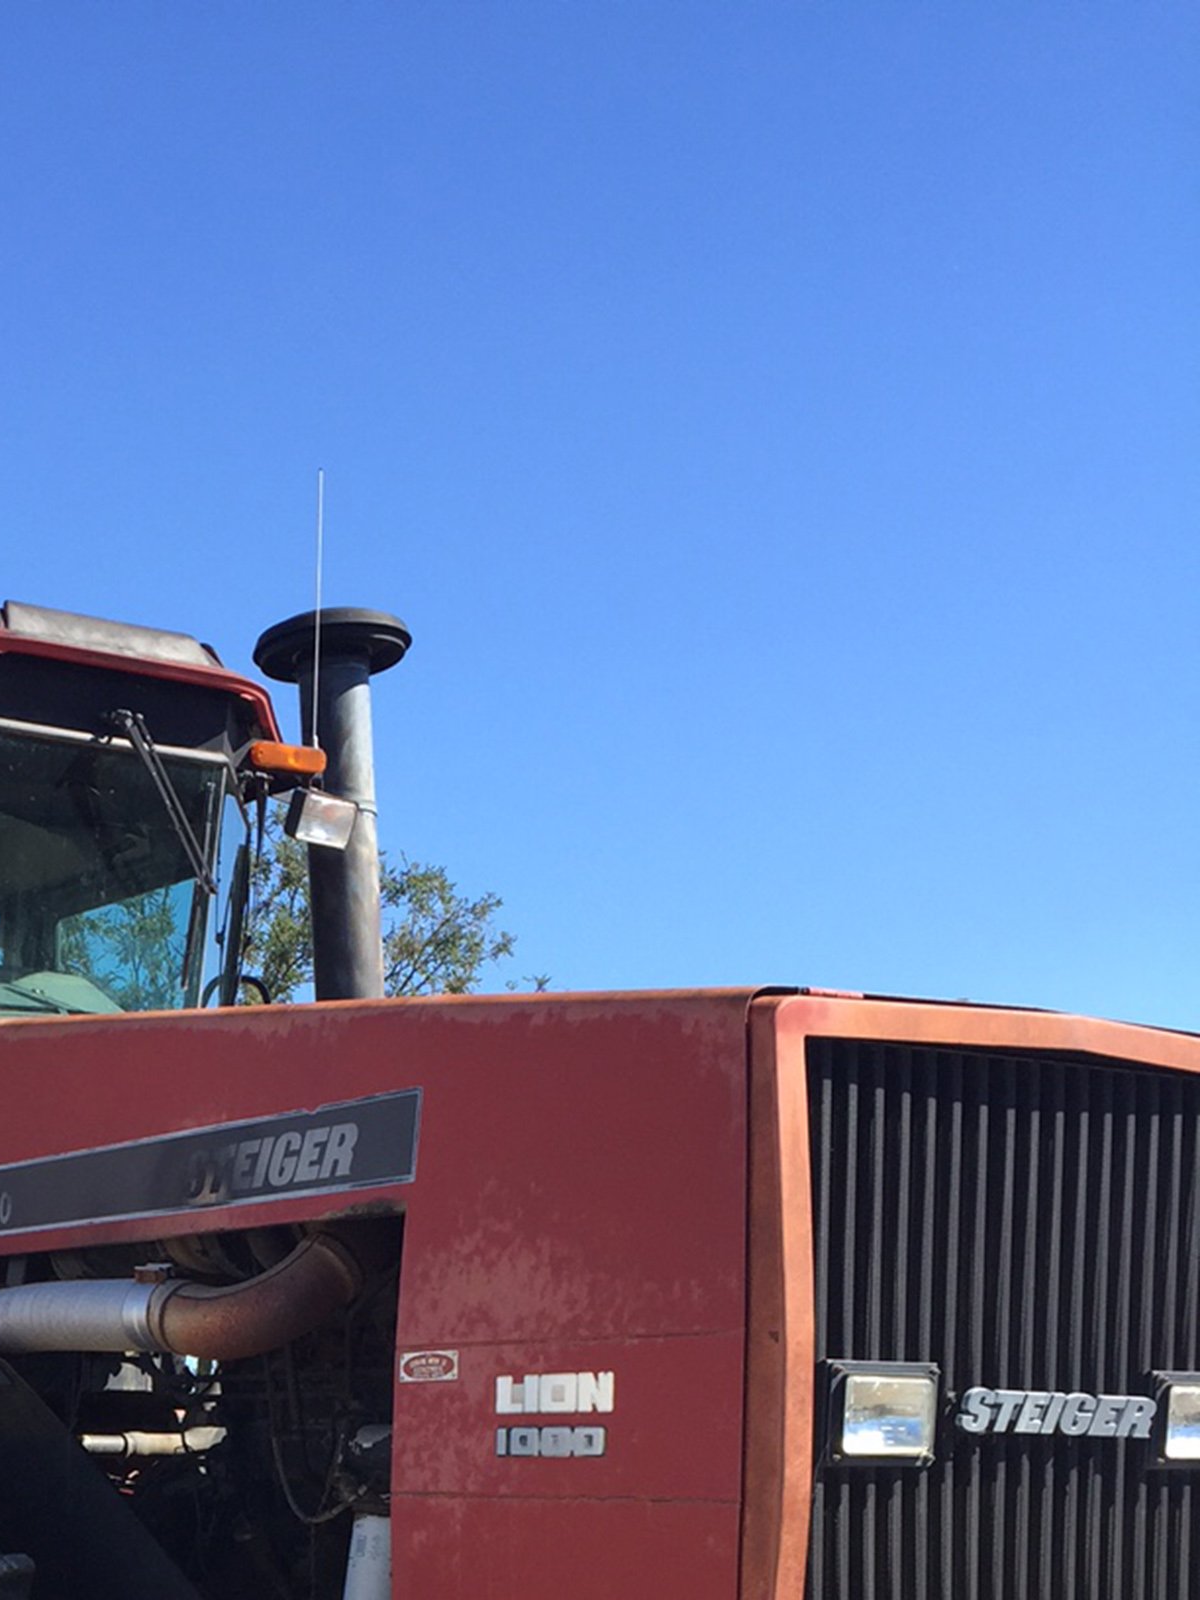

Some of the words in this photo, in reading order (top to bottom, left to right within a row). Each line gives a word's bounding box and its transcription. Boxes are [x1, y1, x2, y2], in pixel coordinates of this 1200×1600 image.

[189, 1122, 359, 1190] TEIGER
[495, 1371, 614, 1414] LION
[956, 1386, 1157, 1438] STEIGER
